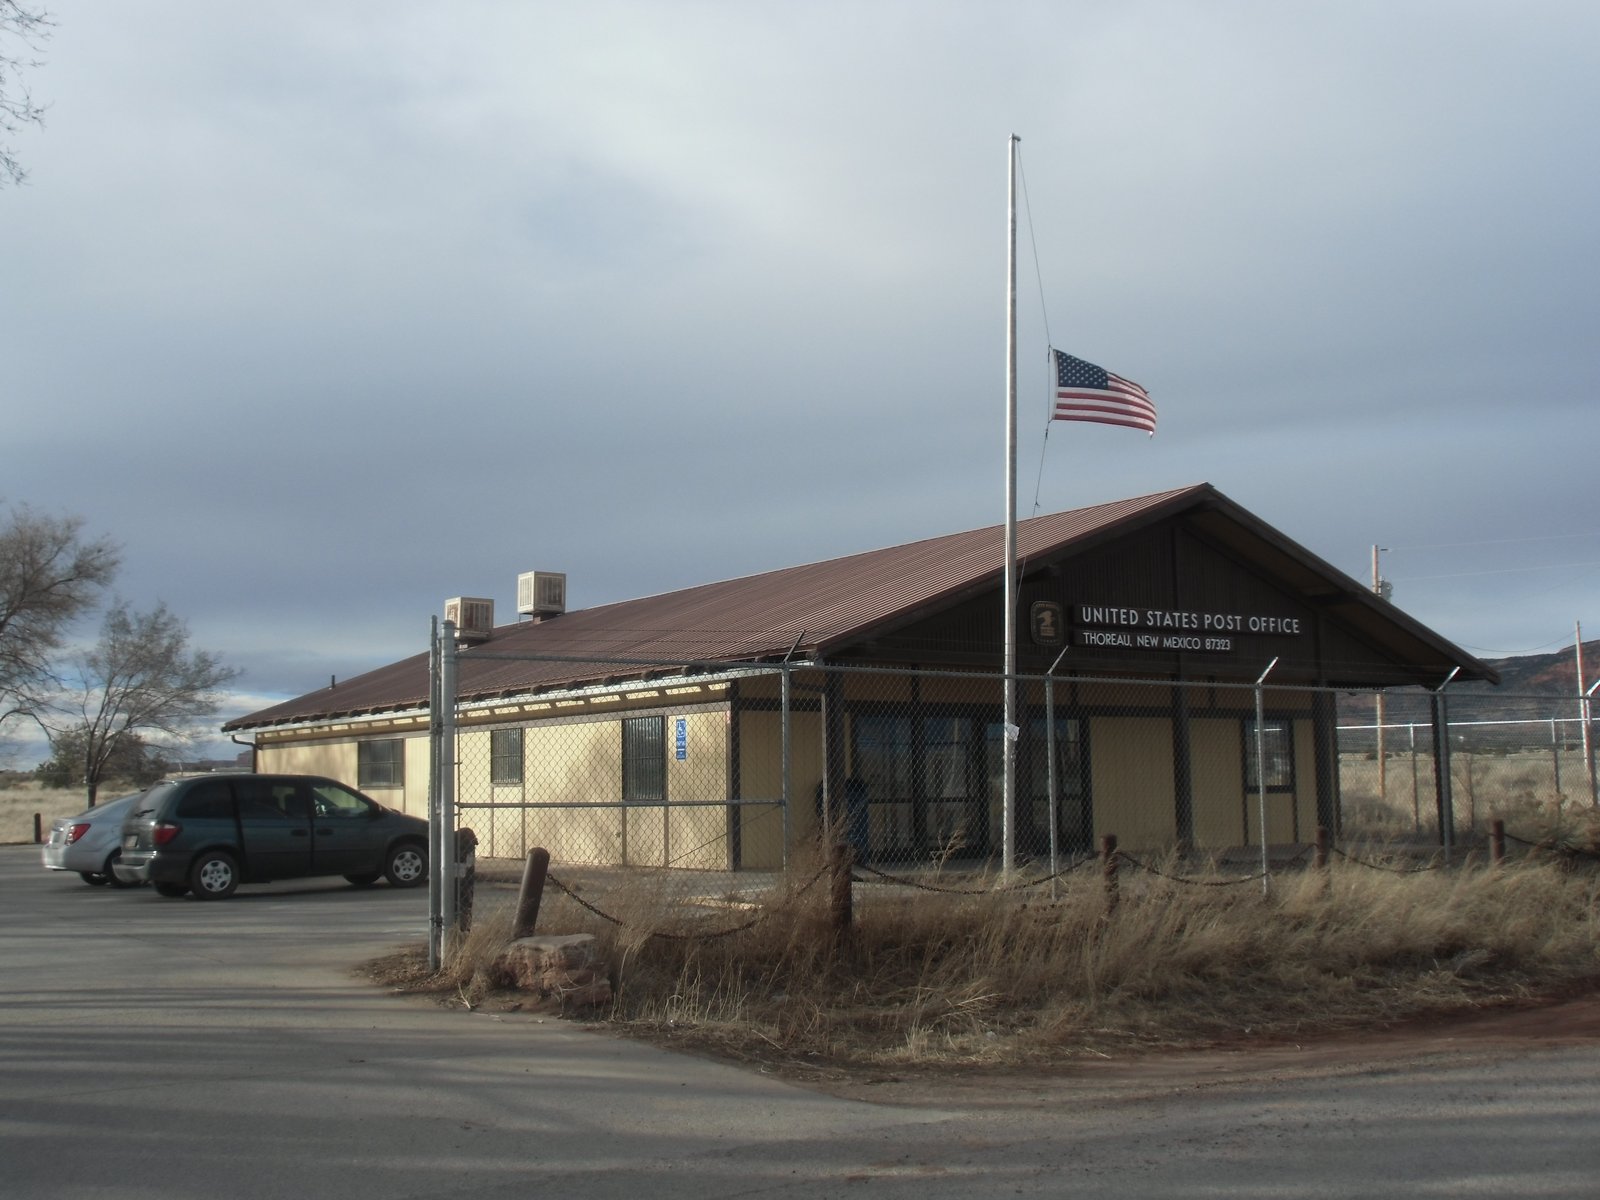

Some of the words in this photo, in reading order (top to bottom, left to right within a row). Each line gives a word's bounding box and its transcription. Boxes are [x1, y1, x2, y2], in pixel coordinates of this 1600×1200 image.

[1082, 606, 1139, 625] UNITED
[1146, 611, 1198, 629] STATES
[1204, 614, 1242, 631] POST
[1248, 616, 1301, 633] OFFICE
[1137, 634, 1158, 647] NEW
[1163, 636, 1201, 650] MEXICO
[1205, 638, 1231, 651] 87323
